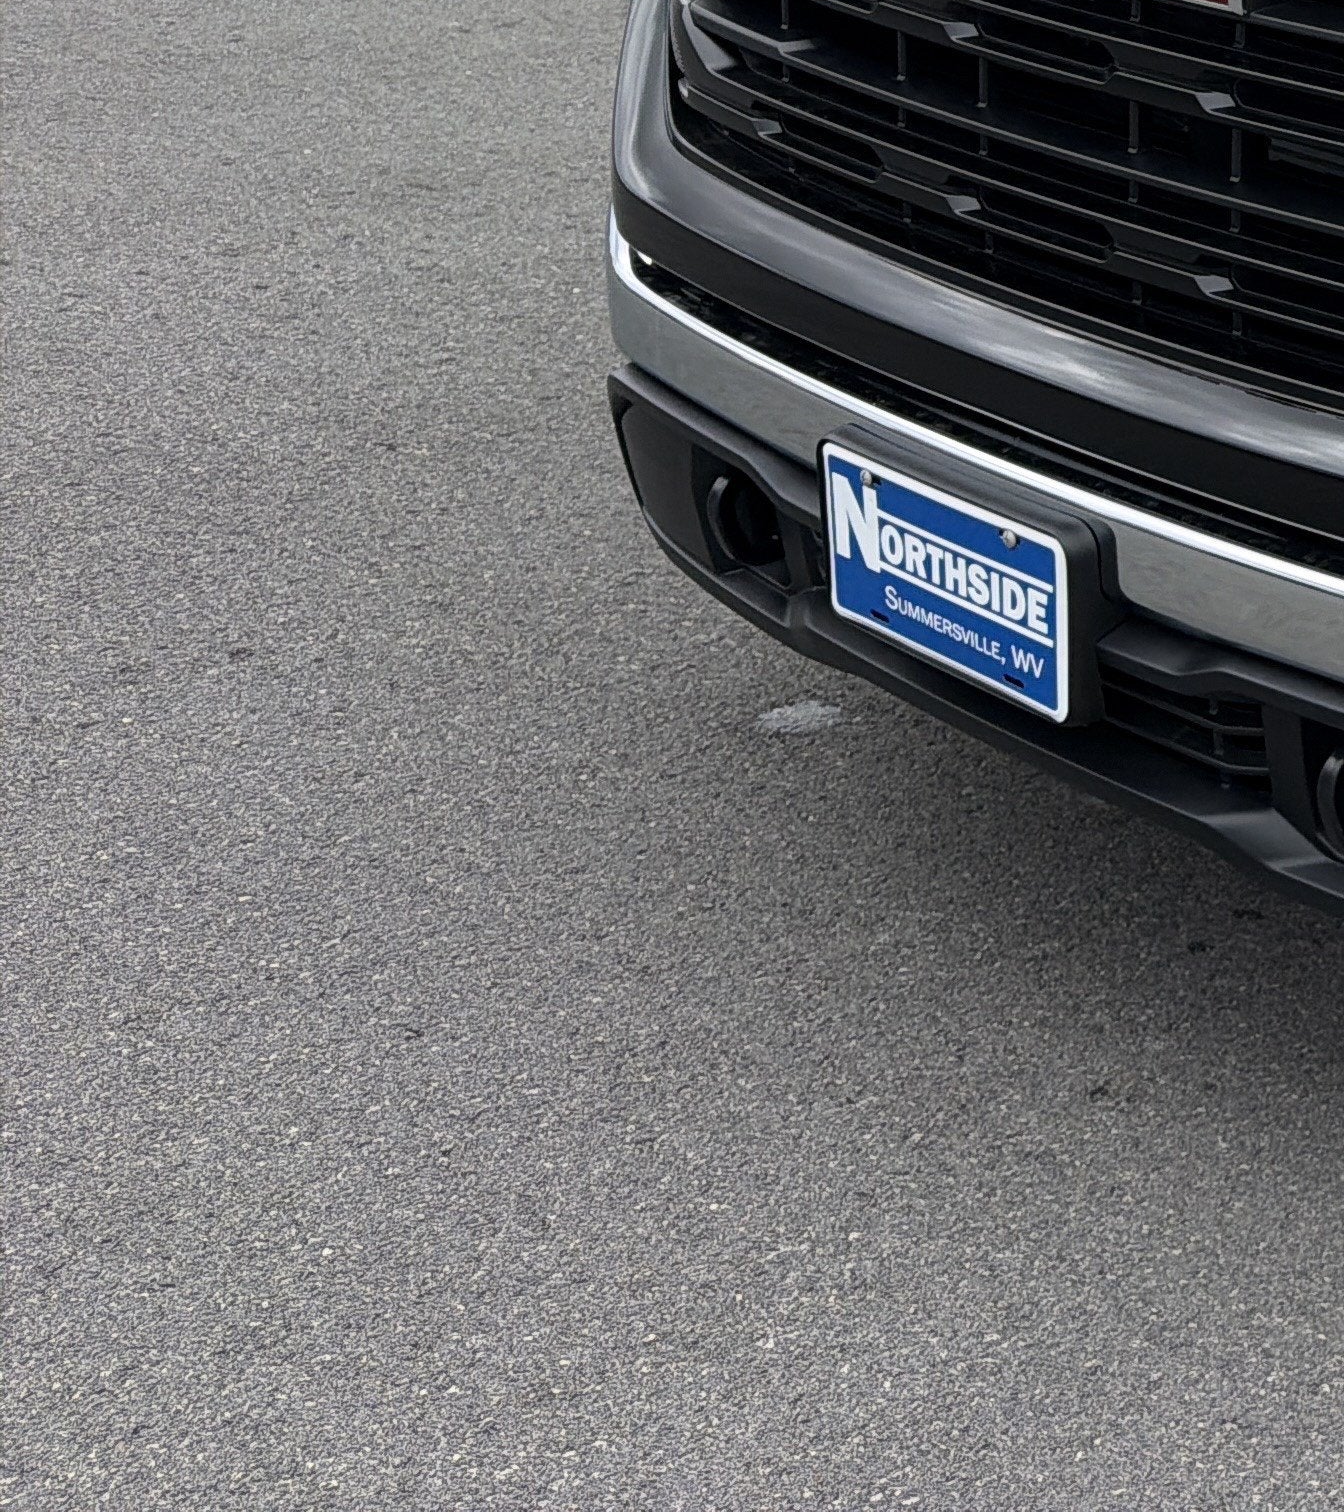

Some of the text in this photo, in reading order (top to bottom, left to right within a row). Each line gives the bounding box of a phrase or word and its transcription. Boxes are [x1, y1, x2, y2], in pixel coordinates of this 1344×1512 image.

[831, 472, 1050, 636] NORTHSIDE
[884, 585, 1046, 679] SUMMERSVILLE, WV
